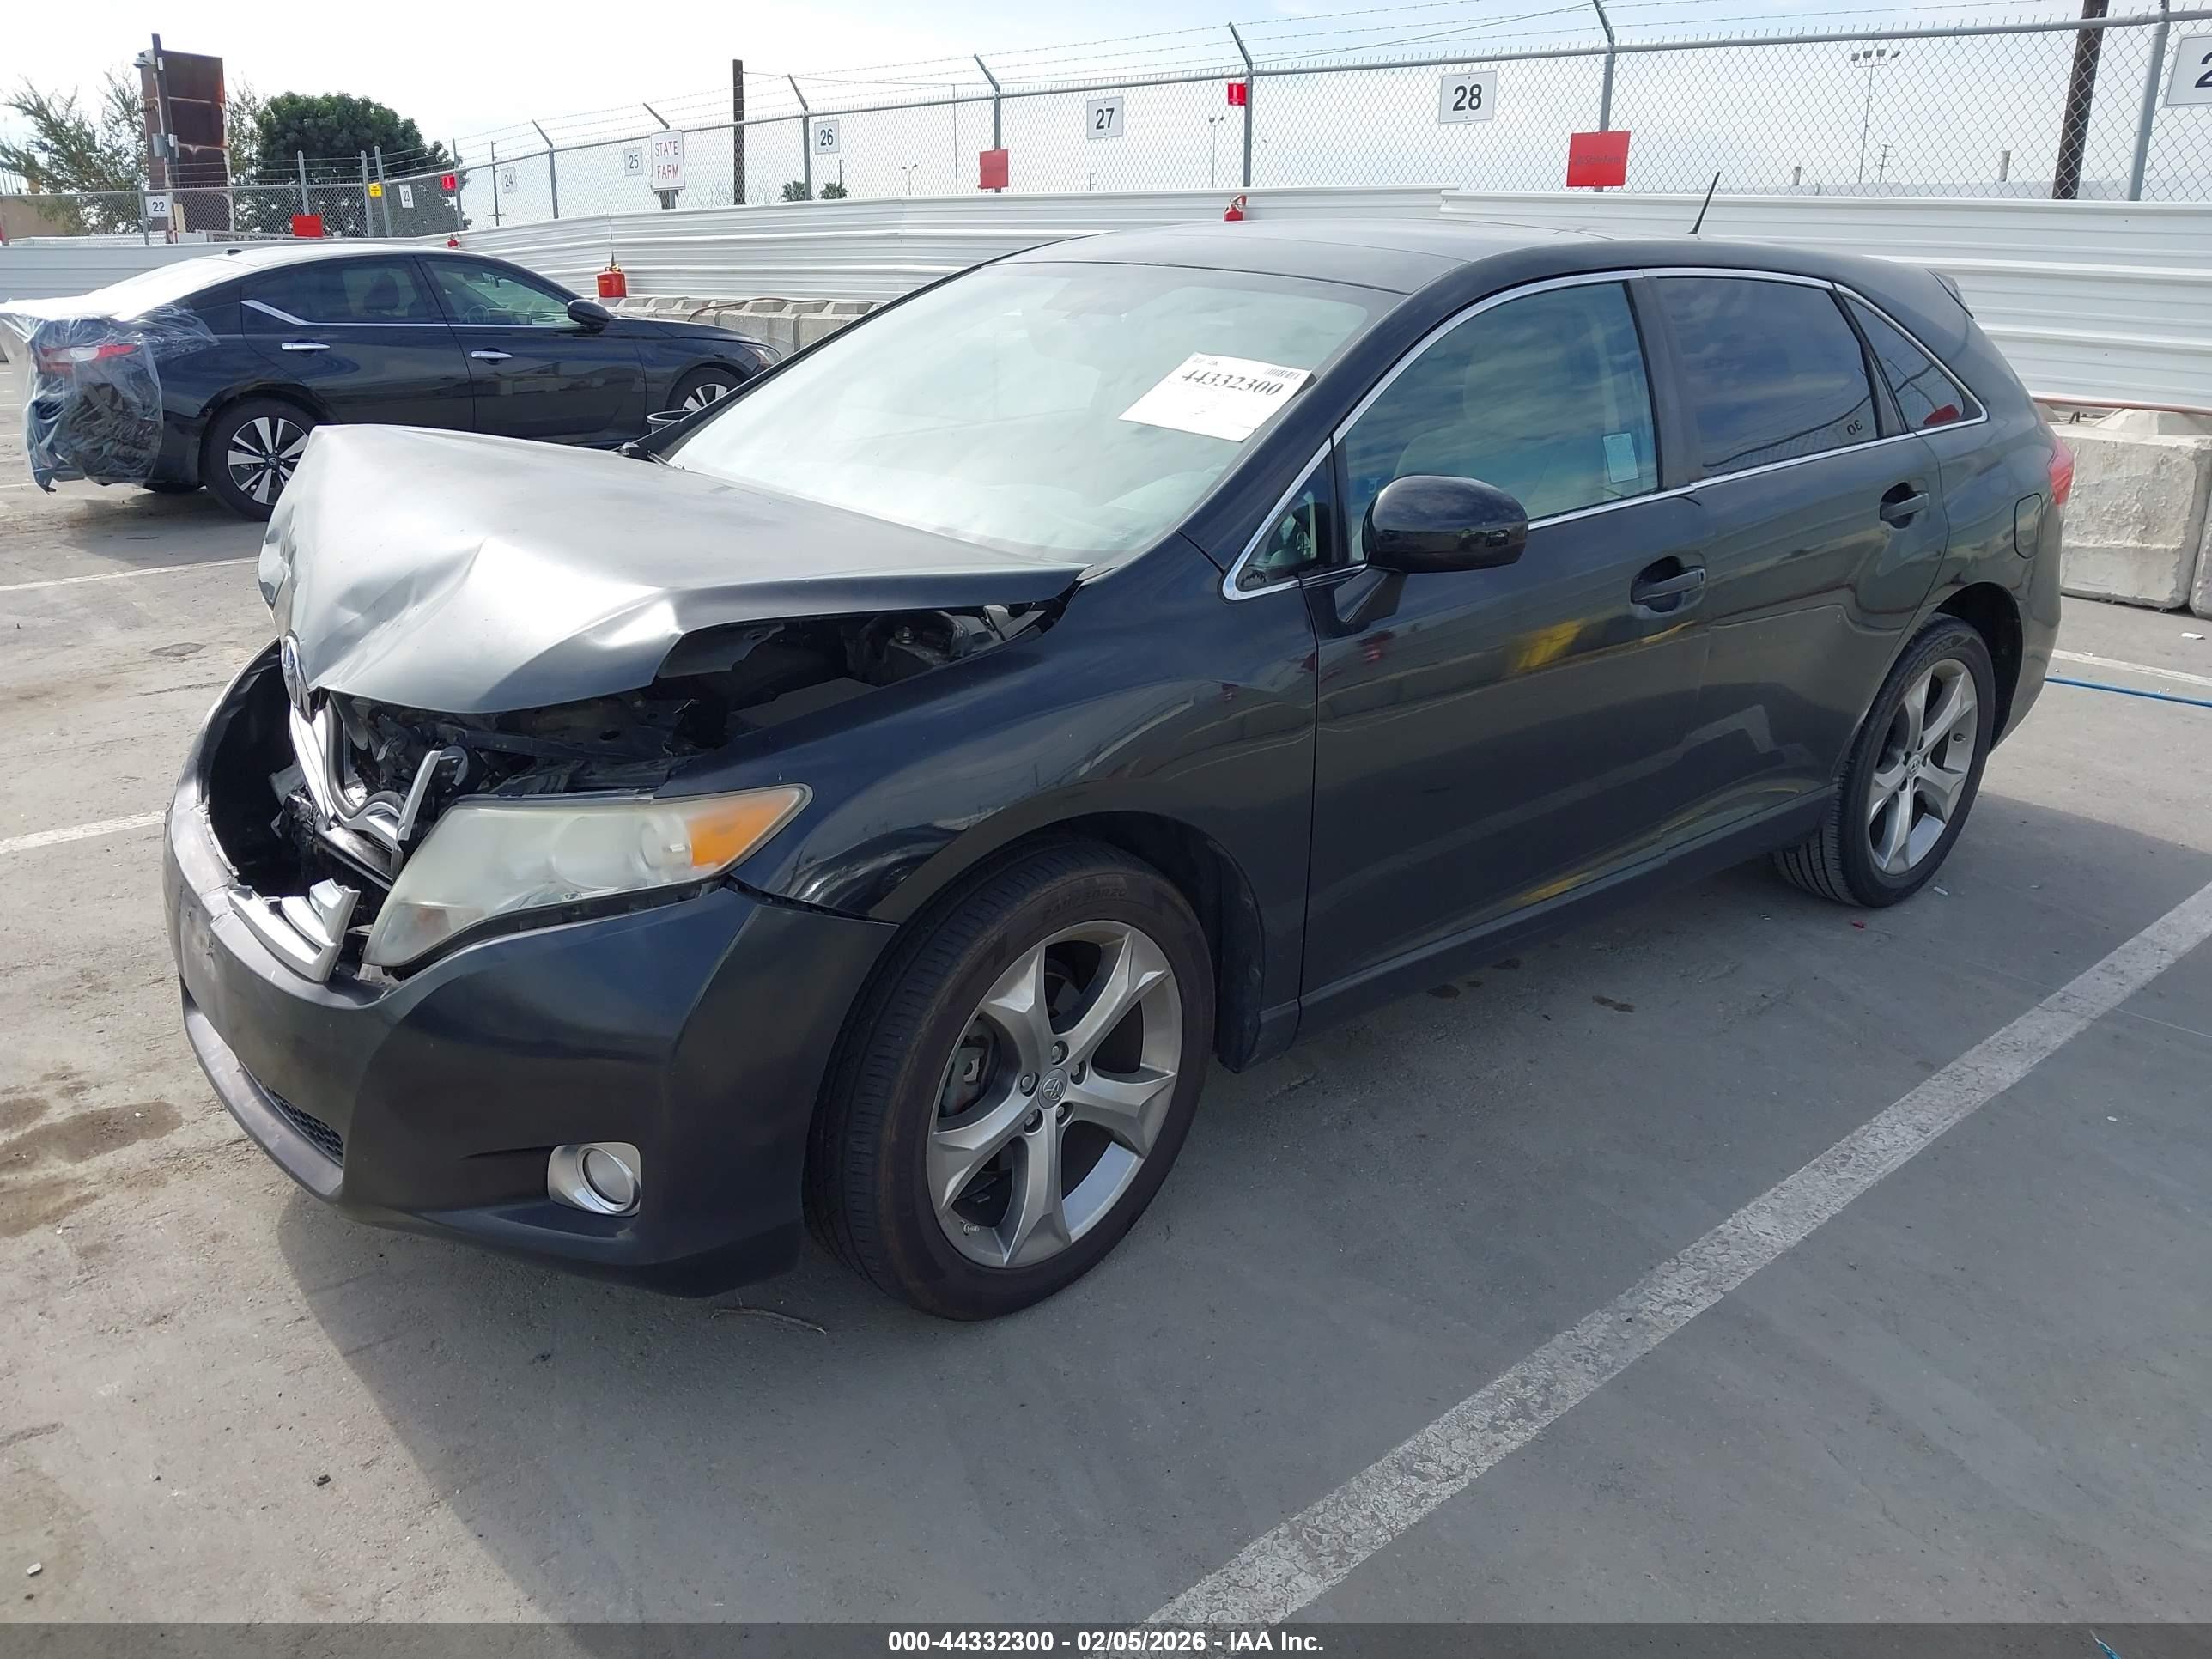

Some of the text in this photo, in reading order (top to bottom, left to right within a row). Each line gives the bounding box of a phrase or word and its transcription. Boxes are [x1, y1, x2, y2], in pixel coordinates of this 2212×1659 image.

[1452, 83, 1482, 111] 28
[1096, 107, 1115, 130] 27
[820, 128, 834, 146] 26
[655, 141, 678, 156] STATE
[629, 155, 639, 169] 25
[657, 164, 679, 179] FARM
[504, 174, 514, 187] 24
[403, 190, 410, 202] 23
[152, 201, 166, 212] 22
[1181, 369, 1285, 395] 44332300
